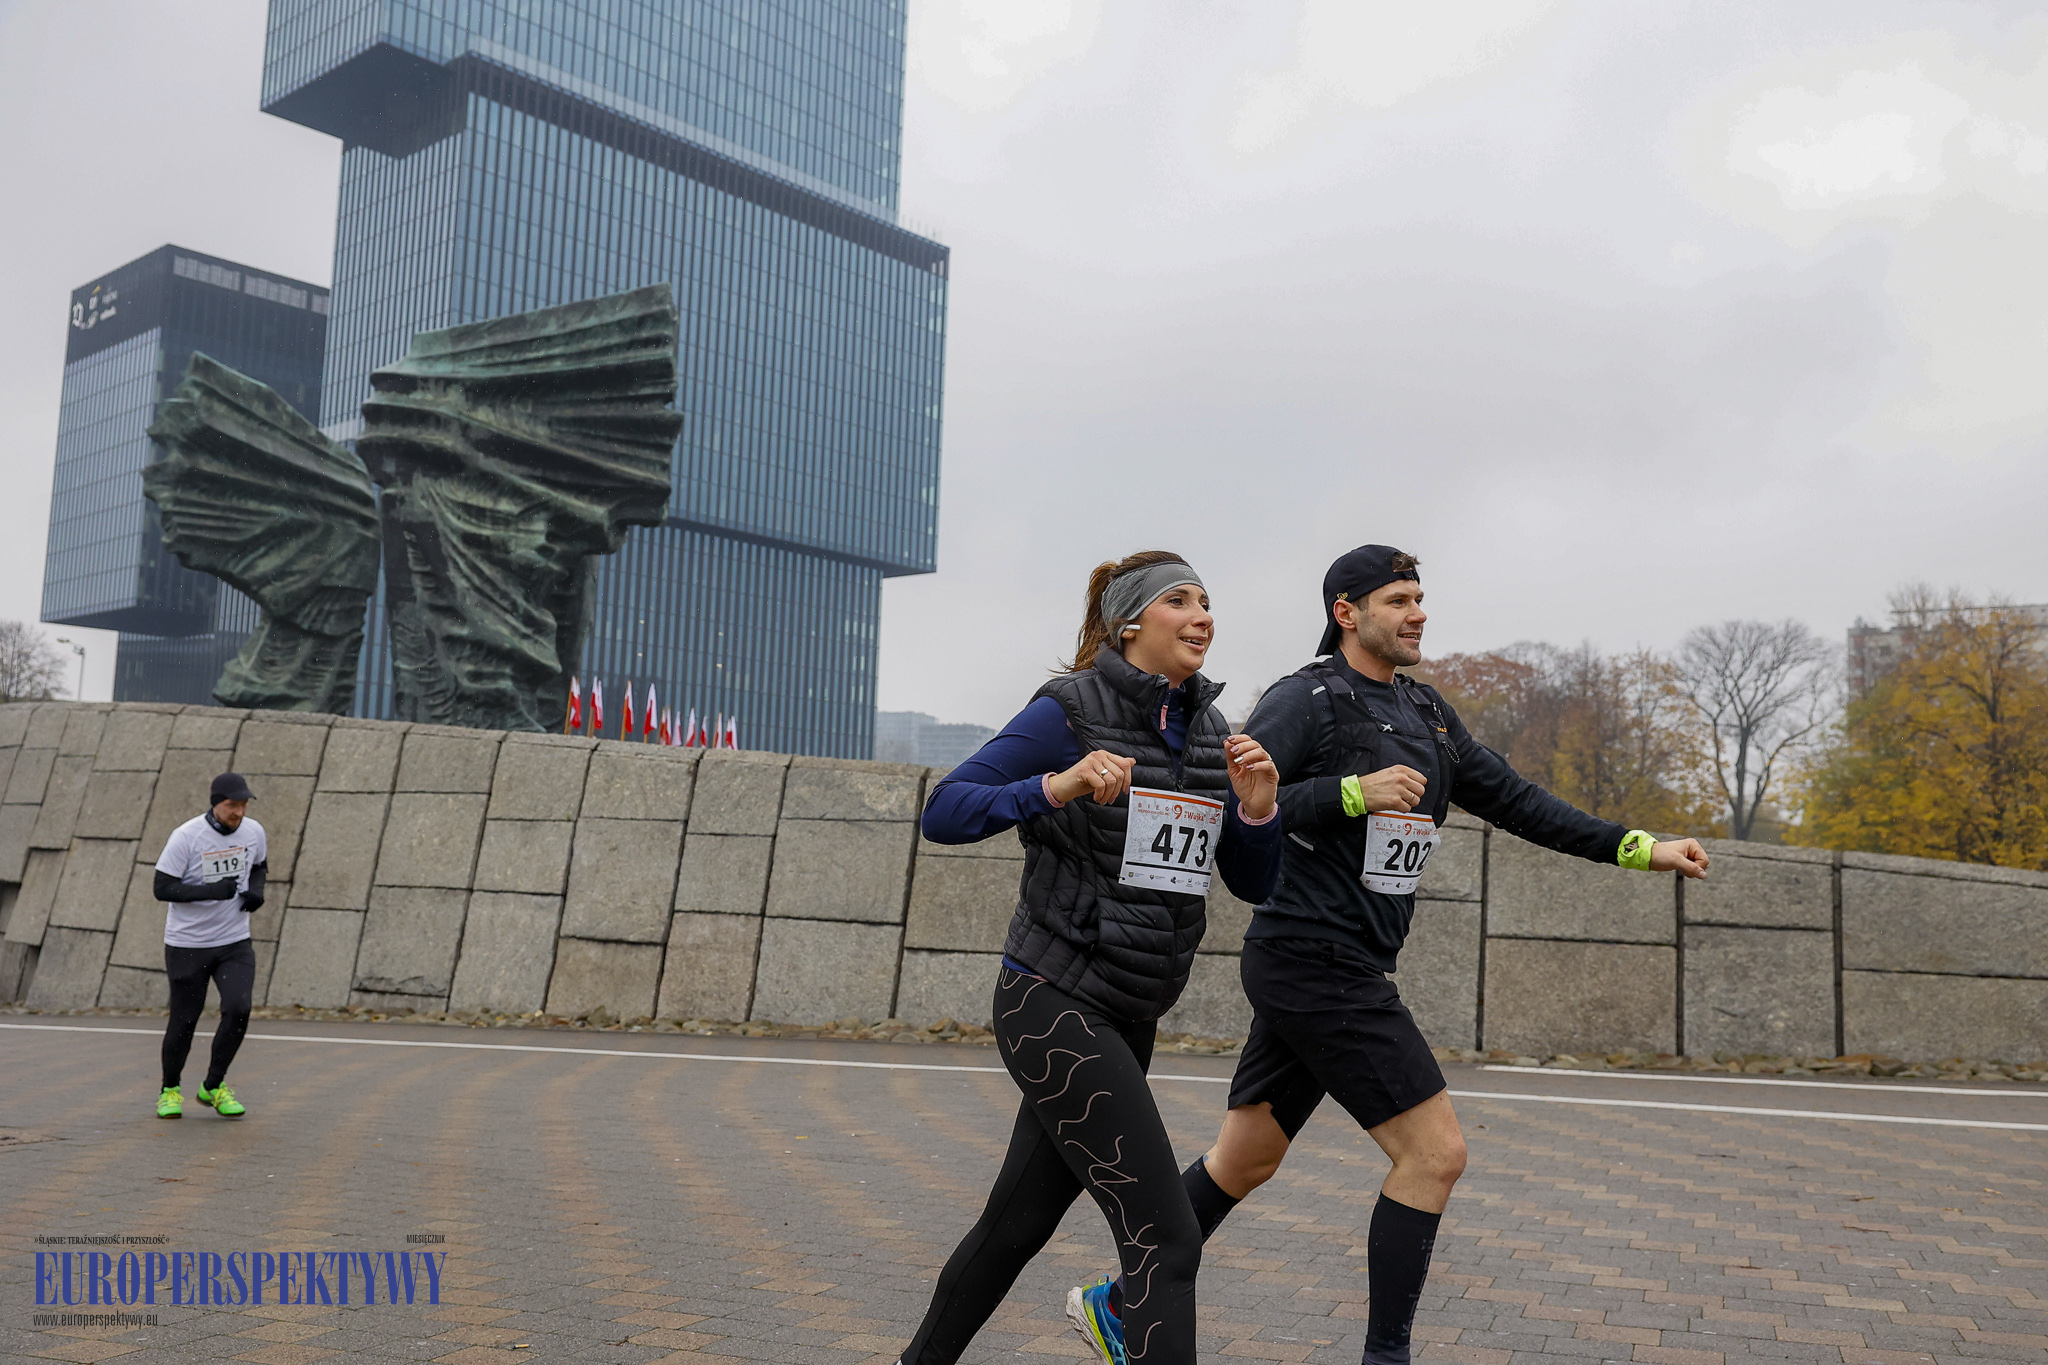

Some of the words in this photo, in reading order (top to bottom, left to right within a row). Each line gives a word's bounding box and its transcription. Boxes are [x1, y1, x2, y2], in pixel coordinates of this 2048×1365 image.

[1151, 823, 1208, 868] 473
[1384, 838, 1432, 872] 202
[212, 857, 239, 873] 119
